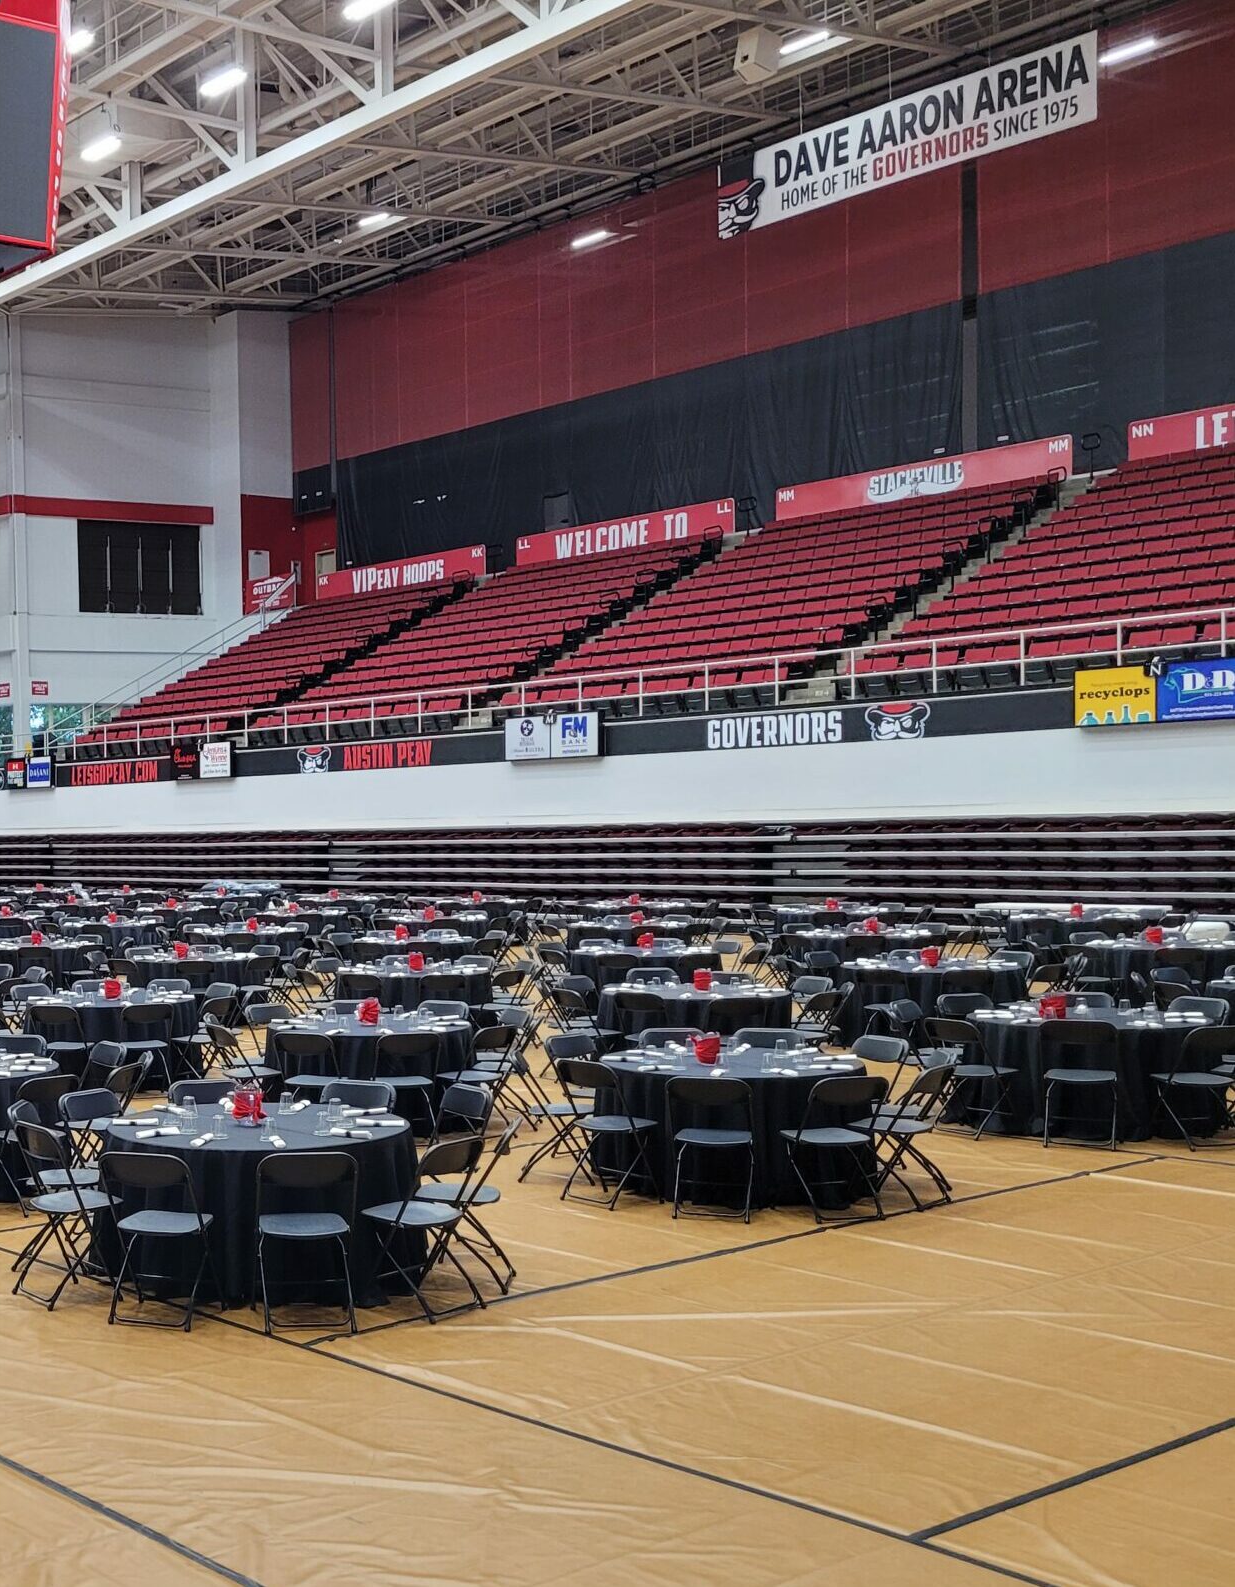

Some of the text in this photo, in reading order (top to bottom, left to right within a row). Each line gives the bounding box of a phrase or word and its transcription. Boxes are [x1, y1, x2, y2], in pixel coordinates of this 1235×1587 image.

[774, 44, 1089, 187] DAVE AARON ARENA
[781, 95, 1079, 211] HOME OF THE GOVERNORS SINCE 1975
[1132, 423, 1153, 438] NN
[1049, 440, 1068, 453] MM
[779, 490, 795, 502] MM
[717, 502, 731, 514] LL
[556, 512, 688, 560] WELCOME TO
[518, 538, 530, 550] LL
[471, 547, 483, 558] KK
[402, 559, 444, 587] HOOPS
[319, 576, 329, 586] KK
[1149, 663, 1162, 676] N
[1080, 686, 1150, 701] recyclops
[707, 711, 842, 749] GOVERNORS
[343, 740, 432, 770] AUSTIN PEAY
[29, 768, 49, 777] DASANI
[71, 761, 158, 786] LETSGOPEAY.COM
